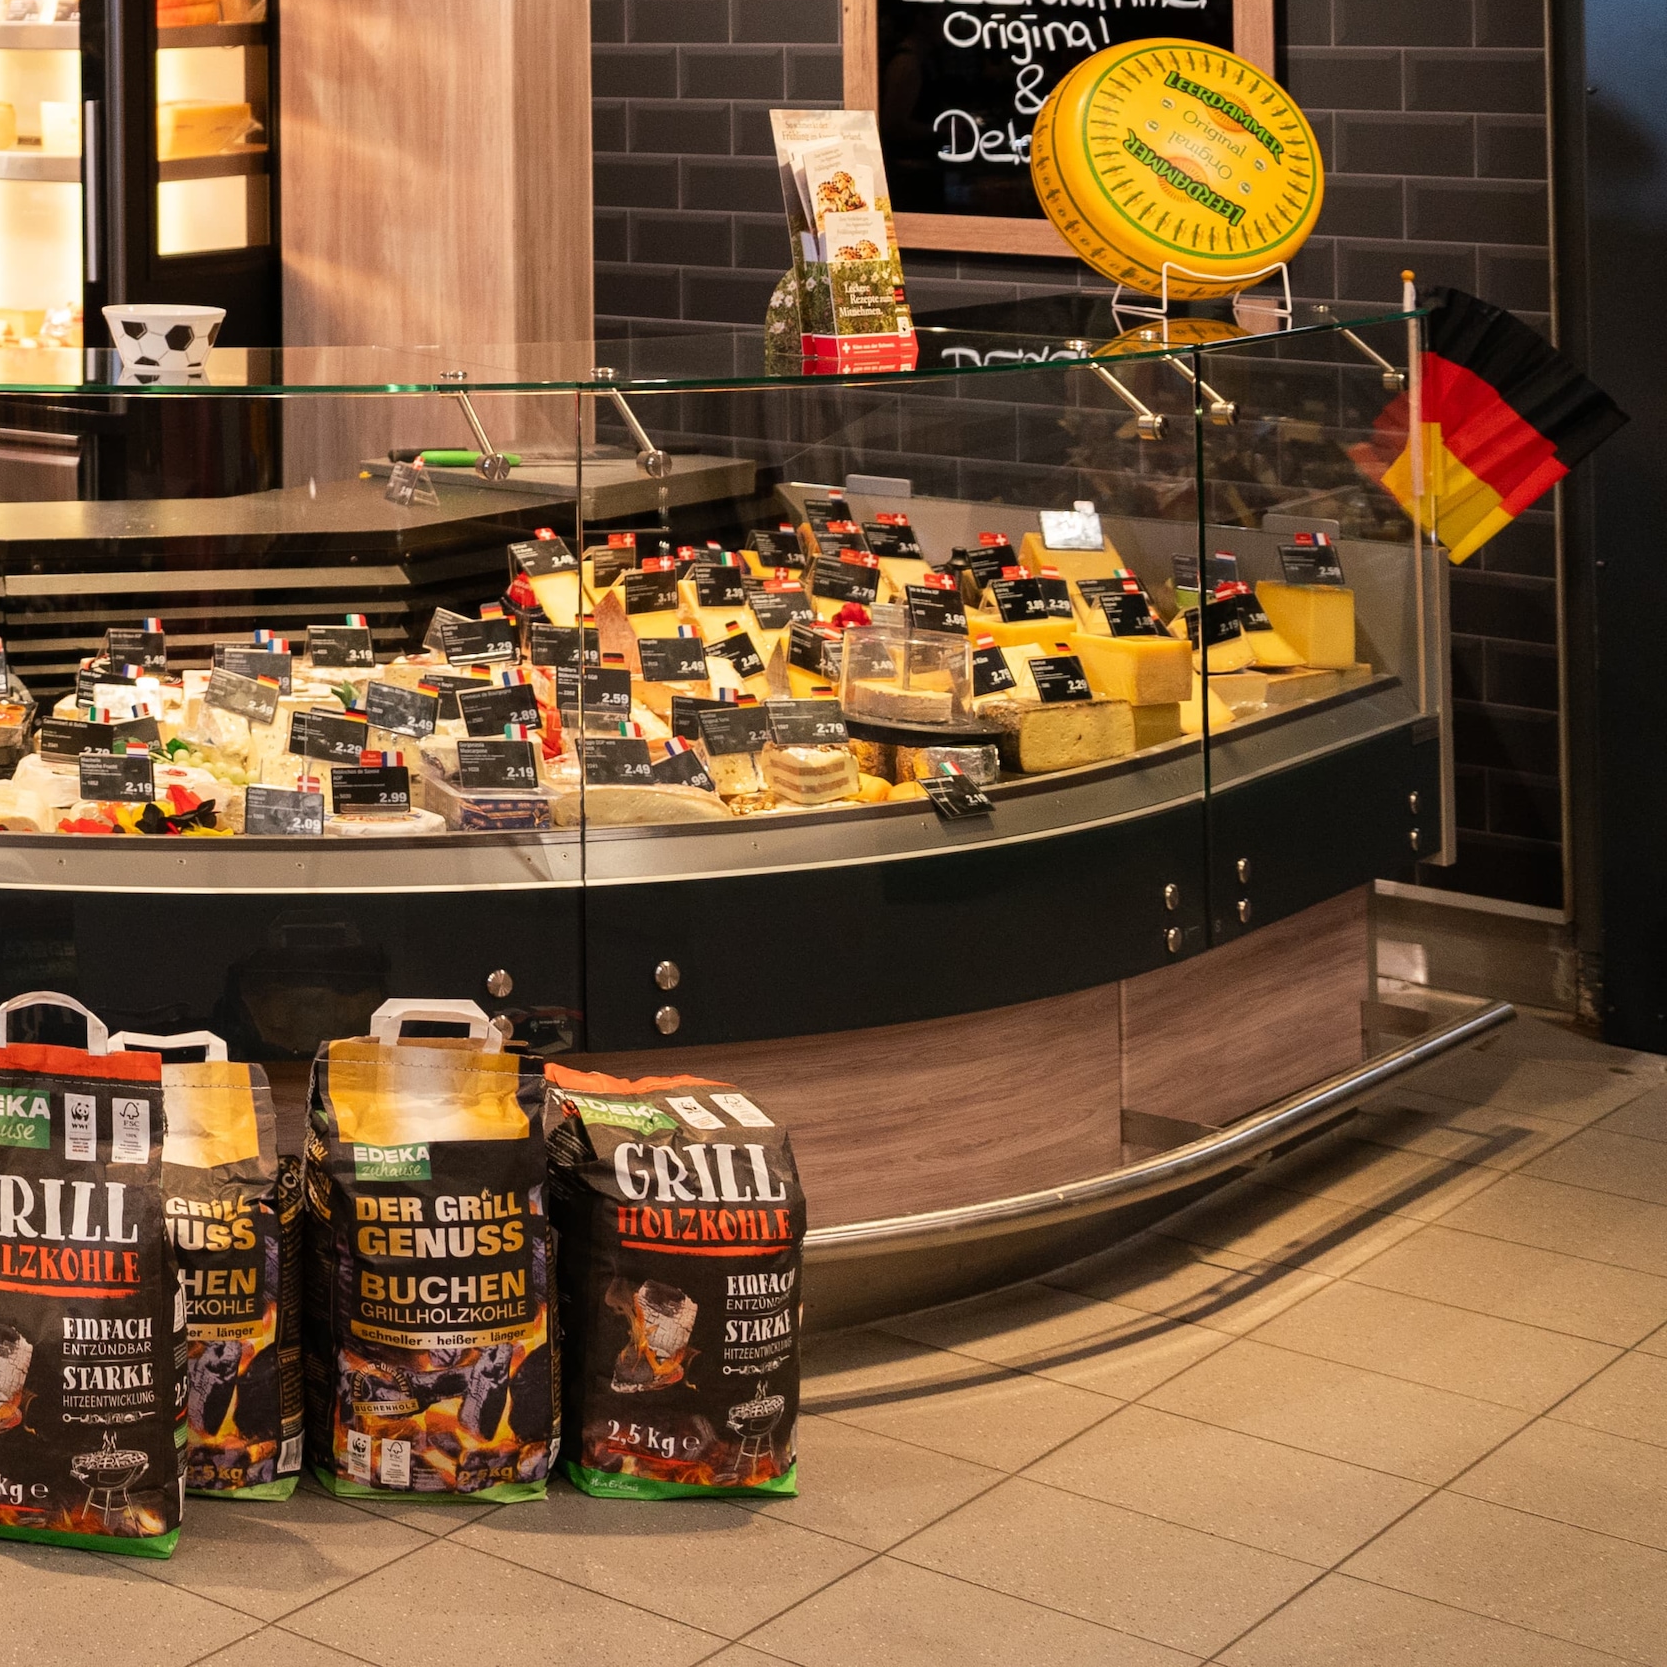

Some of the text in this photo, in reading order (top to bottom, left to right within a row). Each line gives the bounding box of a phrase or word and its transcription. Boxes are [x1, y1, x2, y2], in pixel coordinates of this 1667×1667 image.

[943, 11, 1110, 65] Original
[1014, 64, 1050, 114] &
[1163, 70, 1285, 166] LEERDAMMER
[1183, 109, 1247, 159] Original
[1170, 131, 1233, 180] Original
[1122, 127, 1247, 227] LEERDAMMER
[850, 294, 879, 307] Rezepte
[349, 649, 372, 660] 3.19
[487, 641, 513, 653] 2.29
[144, 654, 166, 665] 3.49
[680, 660, 705, 672] 2.49
[1067, 679, 1088, 690] 2.29
[601, 692, 629, 704] 2.59
[246, 699, 274, 716] 2.49
[510, 709, 538, 723] 2.89
[407, 715, 434, 731] 2.49
[815, 722, 845, 734] 2.79
[334, 741, 364, 755] 2.29
[506, 766, 534, 777] 2.19
[623, 763, 651, 775] 2.49
[125, 781, 153, 793] 2.19
[379, 792, 408, 804] 2.99
[292, 817, 322, 830] 2.09
[353, 1145, 431, 1163] EDEKA
[360, 1161, 422, 1178] zuhause
[613, 1142, 788, 1203] GRILL
[355, 1195, 424, 1223] DER
[617, 1205, 793, 1240] HOLZKOHLE
[357, 1221, 524, 1259] GENUSS
[360, 1268, 526, 1305] BUCHEN
[726, 1267, 796, 1297] EINFACH
[360, 1300, 527, 1324] GRILLHOLZKOHLE
[62, 1317, 153, 1342] EINFACH
[216, 1325, 255, 1342] länger
[724, 1308, 792, 1344] STARKE
[361, 1328, 526, 1346] schneller heißer länger
[62, 1340, 153, 1357] ENTZÜNDBAR
[62, 1362, 154, 1391] STARKE
[62, 1389, 155, 1407] HITZEENTWICKLUNG
[354, 1400, 417, 1413] BUCHENHOLZ
[607, 1418, 676, 1459] 2,5 kg
